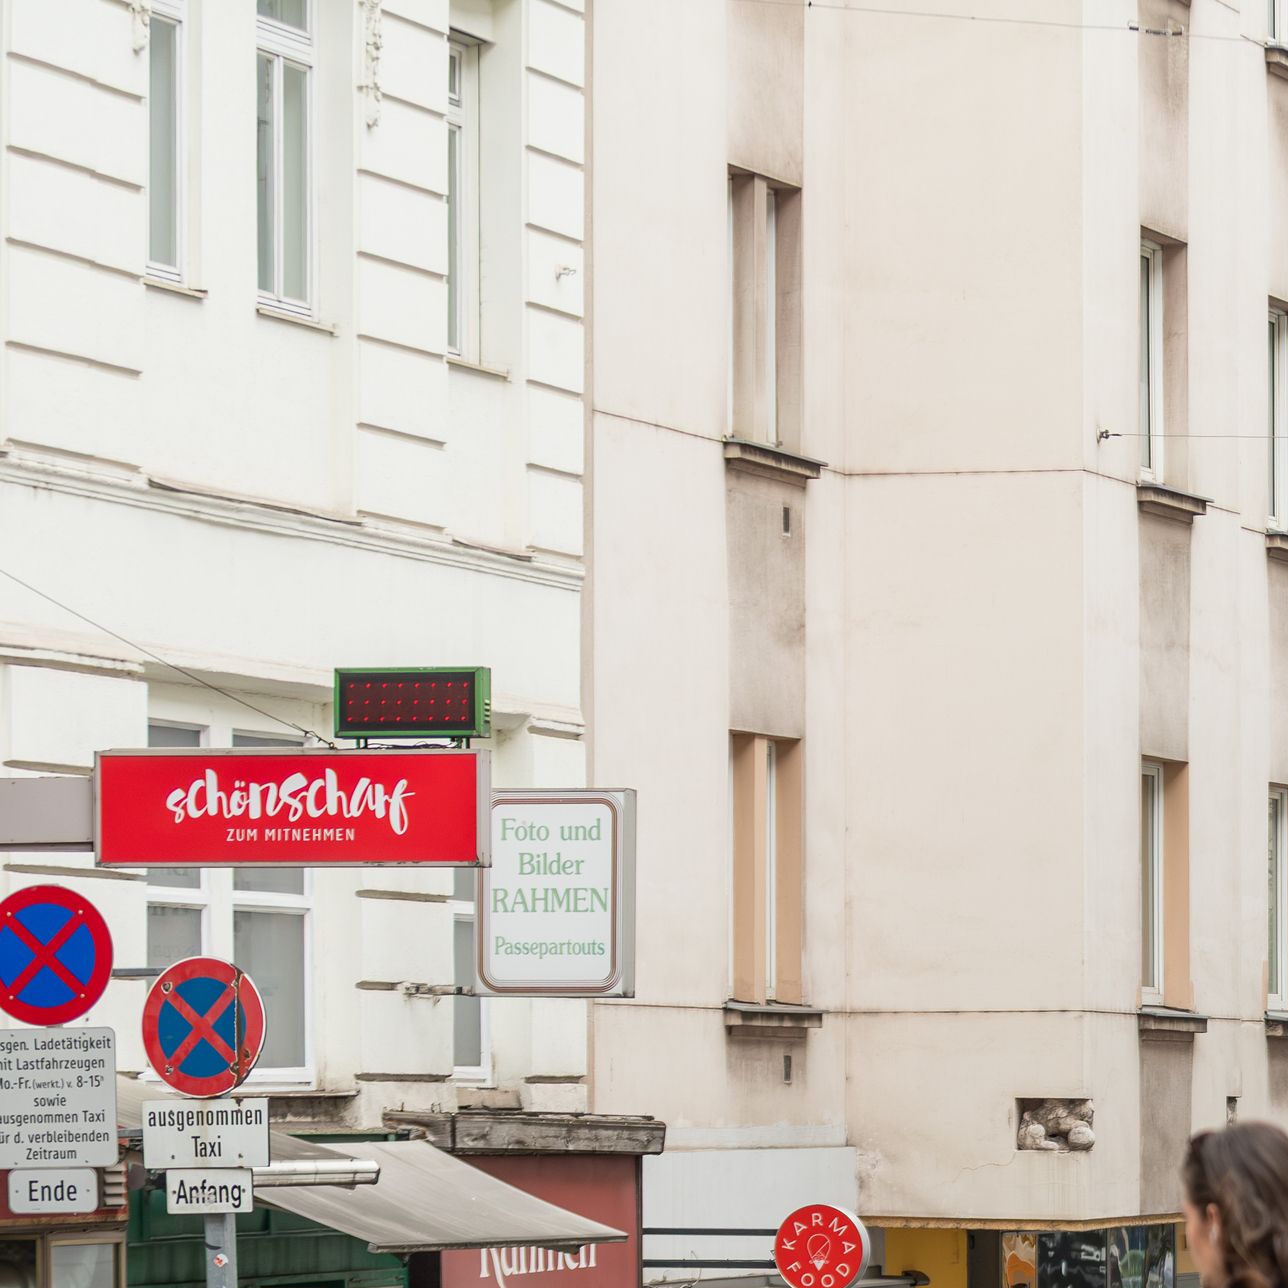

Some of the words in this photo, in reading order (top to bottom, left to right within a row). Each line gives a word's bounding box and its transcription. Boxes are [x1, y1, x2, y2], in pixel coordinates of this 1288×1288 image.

[166, 767, 416, 835] schönscharf
[226, 827, 257, 842] ZUM
[264, 827, 355, 842] MITNEHMEN
[500, 817, 550, 842] Foto
[560, 817, 602, 841] und
[518, 852, 585, 876] Bilder
[491, 887, 609, 913] RAHMEN
[494, 935, 606, 960] Passepartouts
[34, 1036, 111, 1052] Ladetätigkeit
[16, 1057, 105, 1072] Lastfahrzeugen
[33, 1093, 67, 1107] sowie
[82, 1109, 105, 1123] Taxi
[148, 1108, 263, 1132] ausgenommen
[13, 1132, 25, 1144] d.
[28, 1130, 110, 1143] verbleibenden
[191, 1135, 222, 1158] Taxi
[25, 1147, 77, 1161] Zeitraum
[27, 1180, 78, 1203] Ende
[175, 1179, 242, 1208] Anfang
[781, 1212, 857, 1256] KARMA
[786, 1261, 850, 1288] FOOD
